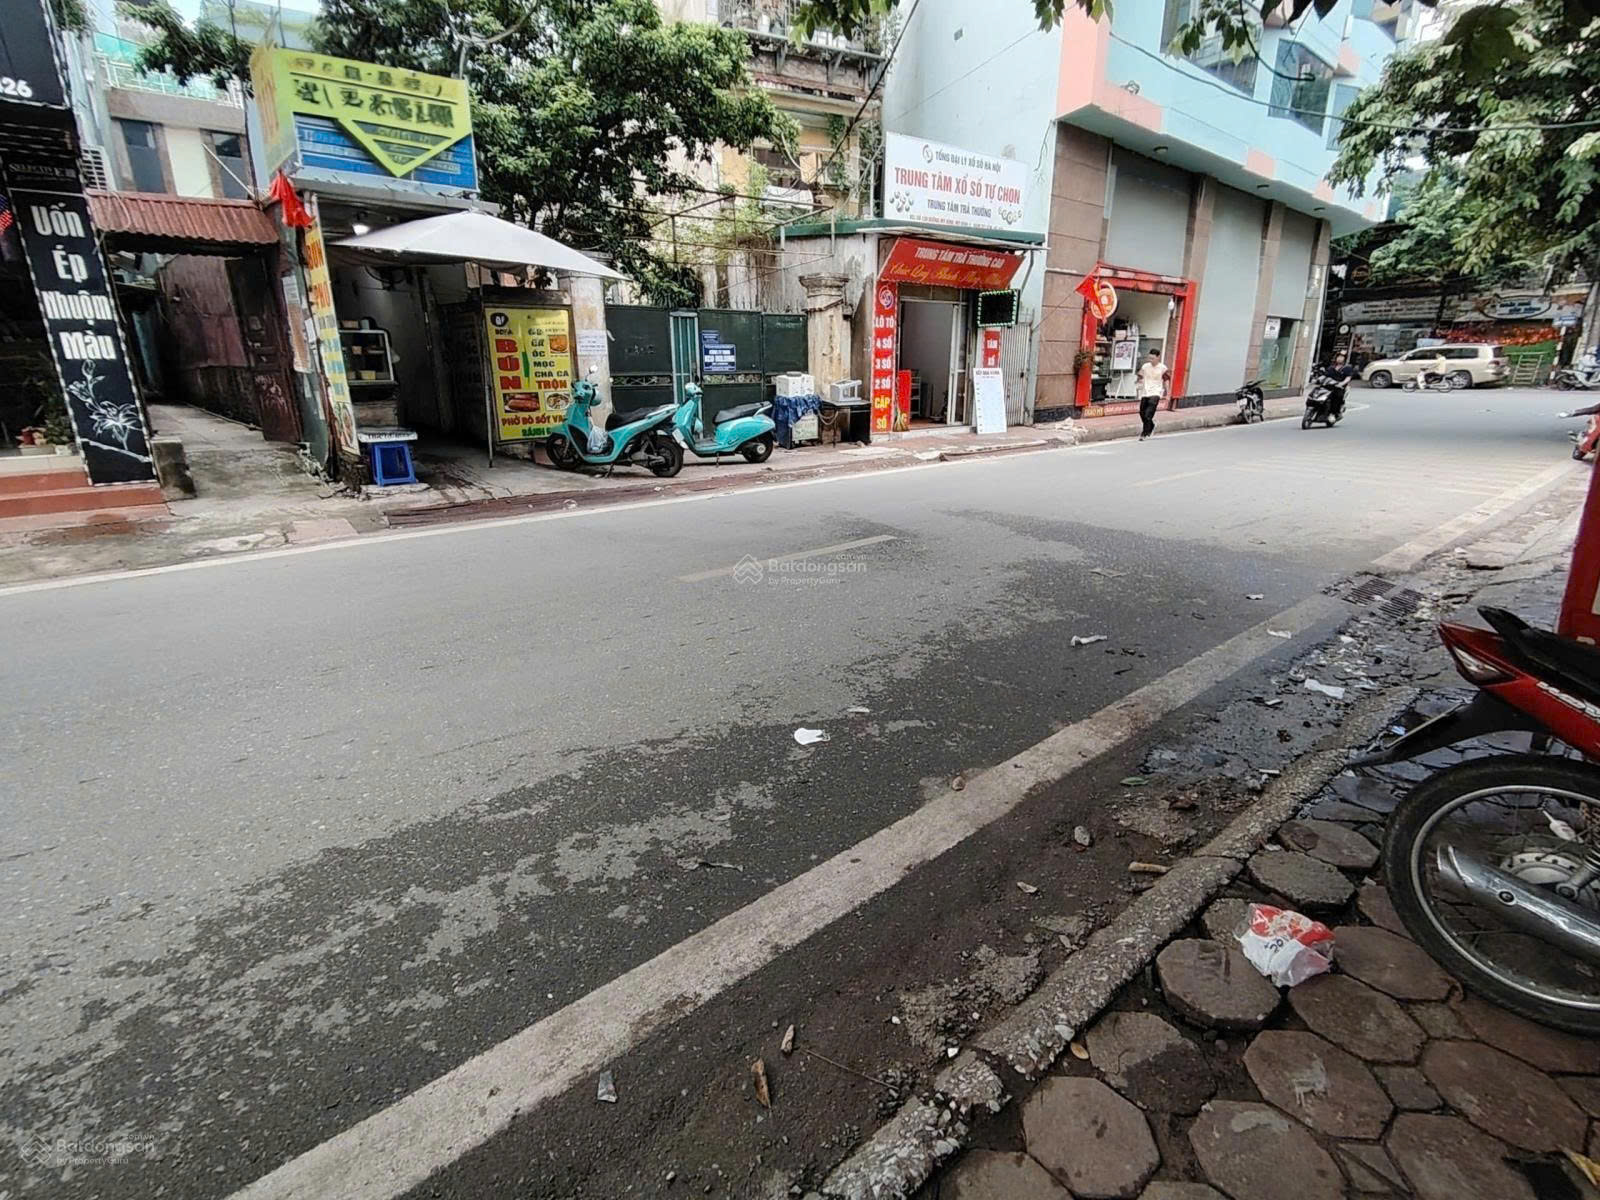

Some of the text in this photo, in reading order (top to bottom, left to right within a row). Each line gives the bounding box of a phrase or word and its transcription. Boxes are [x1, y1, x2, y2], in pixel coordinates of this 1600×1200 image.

[0, 77, 33, 98] 26
[894, 167, 1021, 207] TRUNG TÂM XỔ SỐ TỰ CHỌN
[928, 199, 945, 211] TRUNG
[947, 200, 959, 213] TÂM
[30, 202, 85, 238] Uốn
[52, 244, 88, 283] Ép
[41, 290, 113, 325] Nhuộm
[59, 330, 116, 360] Màu
[882, 334, 892, 349] SỐ
[881, 355, 891, 369] SỐ
[875, 375, 891, 390] 2 SỐ
[876, 415, 887, 429] SỐ
